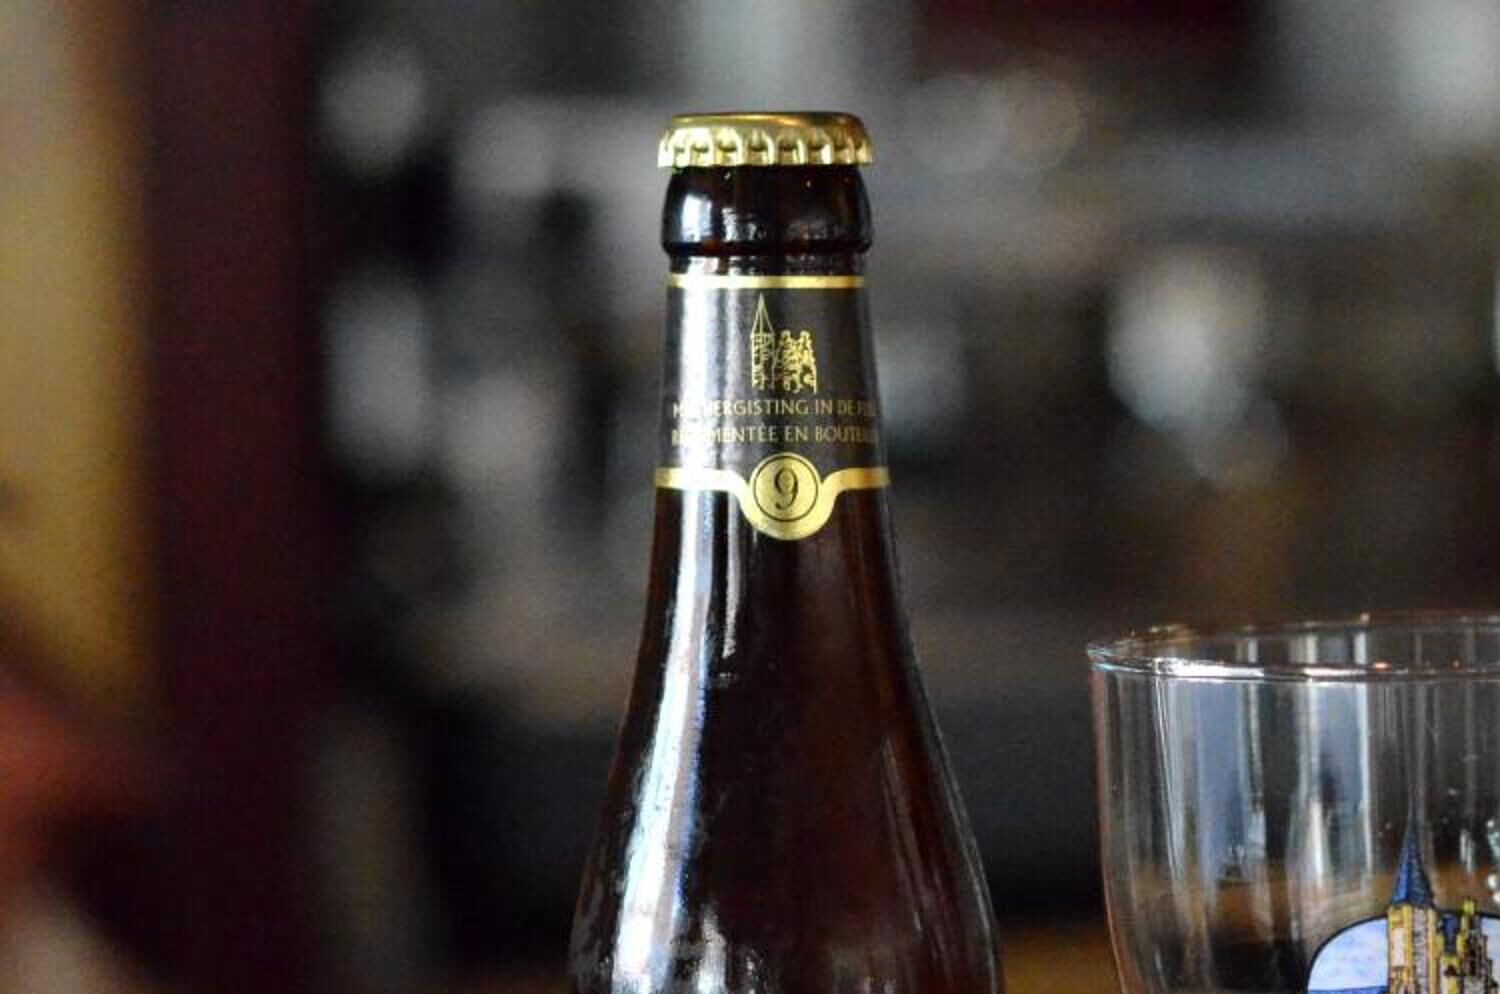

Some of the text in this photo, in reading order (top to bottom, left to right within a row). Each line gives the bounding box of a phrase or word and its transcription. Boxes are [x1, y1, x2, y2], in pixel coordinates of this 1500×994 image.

[815, 399, 833, 416] IN
[784, 426, 809, 442] EN
[773, 466, 799, 511] 9
